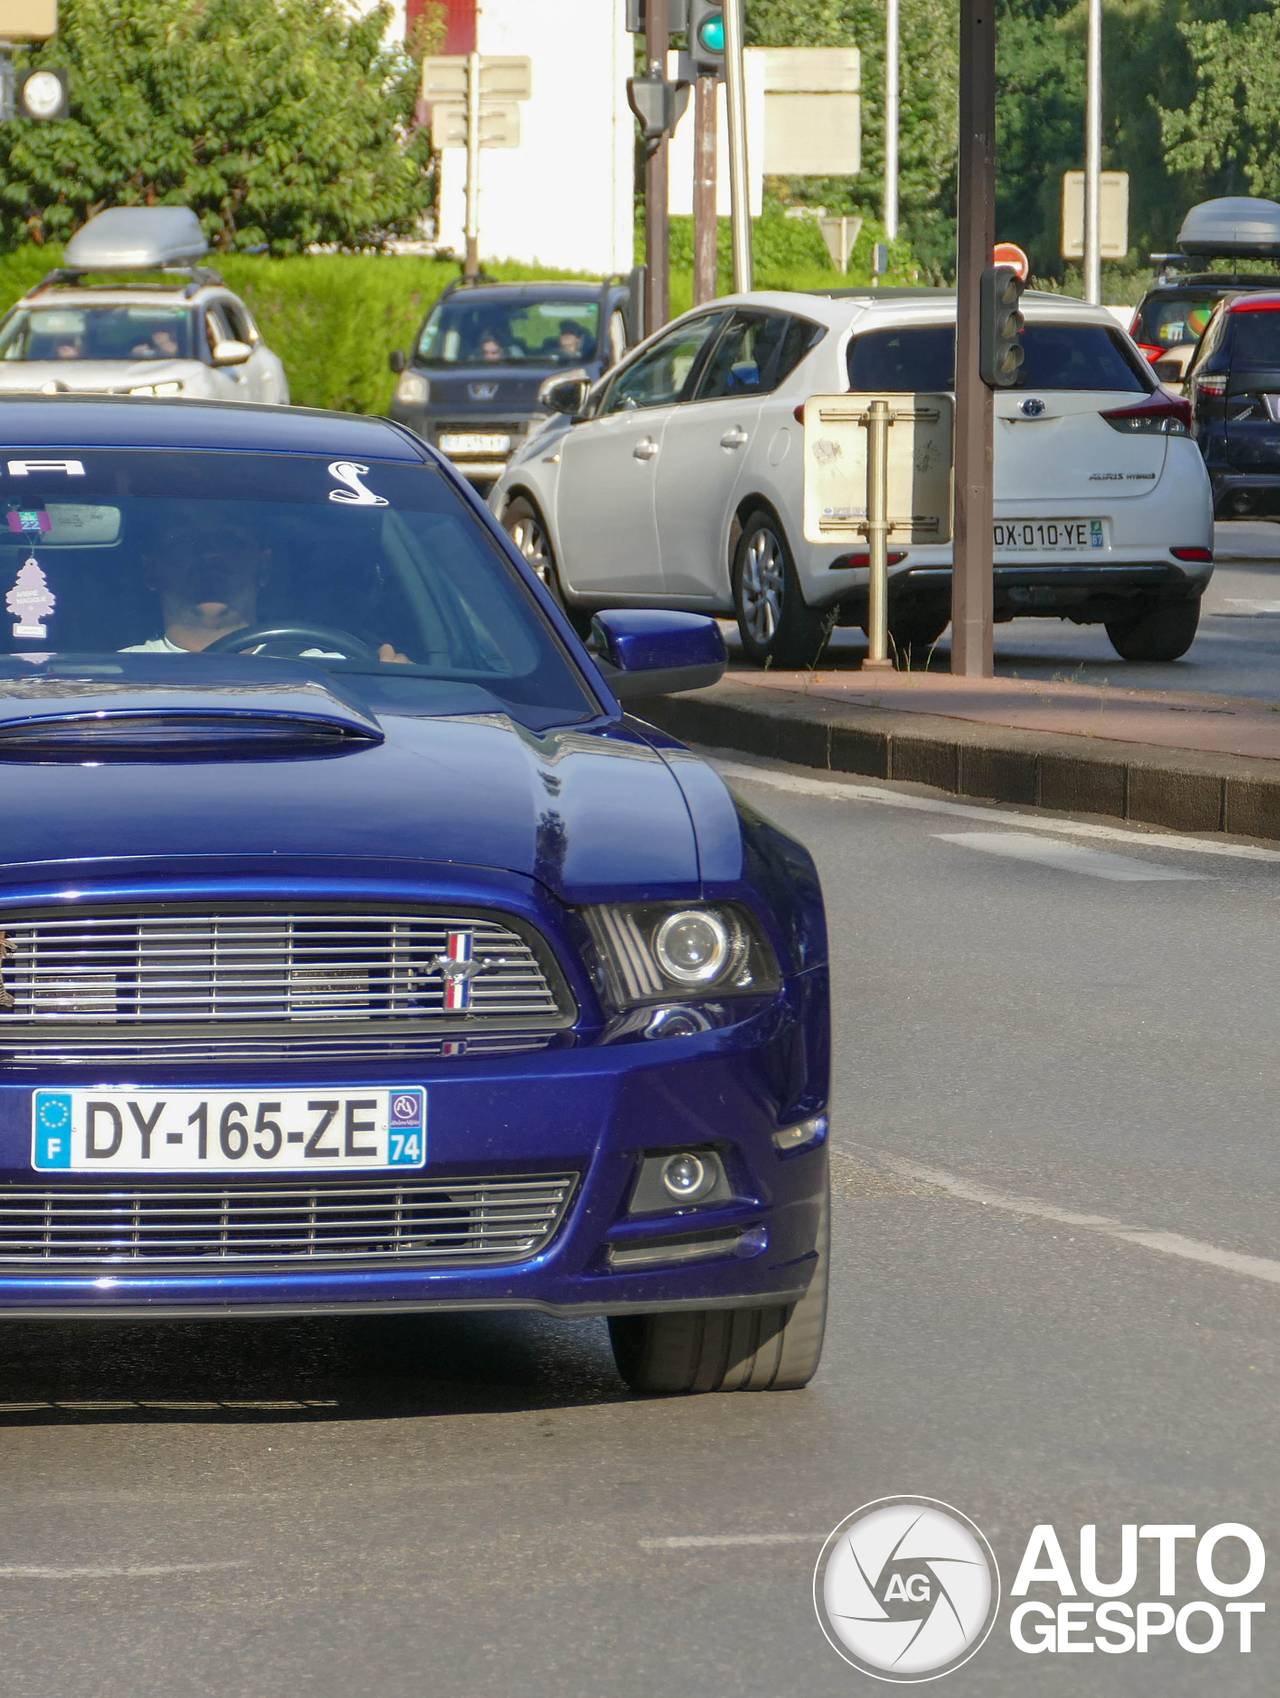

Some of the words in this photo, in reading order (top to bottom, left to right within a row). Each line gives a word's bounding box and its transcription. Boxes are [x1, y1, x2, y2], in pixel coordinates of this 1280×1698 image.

[1089, 473, 1124, 481] AURIS
[21, 520, 41, 531] 22
[993, 524, 1088, 546] DX-010-YE
[1092, 533, 1103, 546] 87
[47, 1138, 61, 1159] F
[85, 1099, 378, 1160] DY-165-ZE
[390, 1134, 421, 1161] 74
